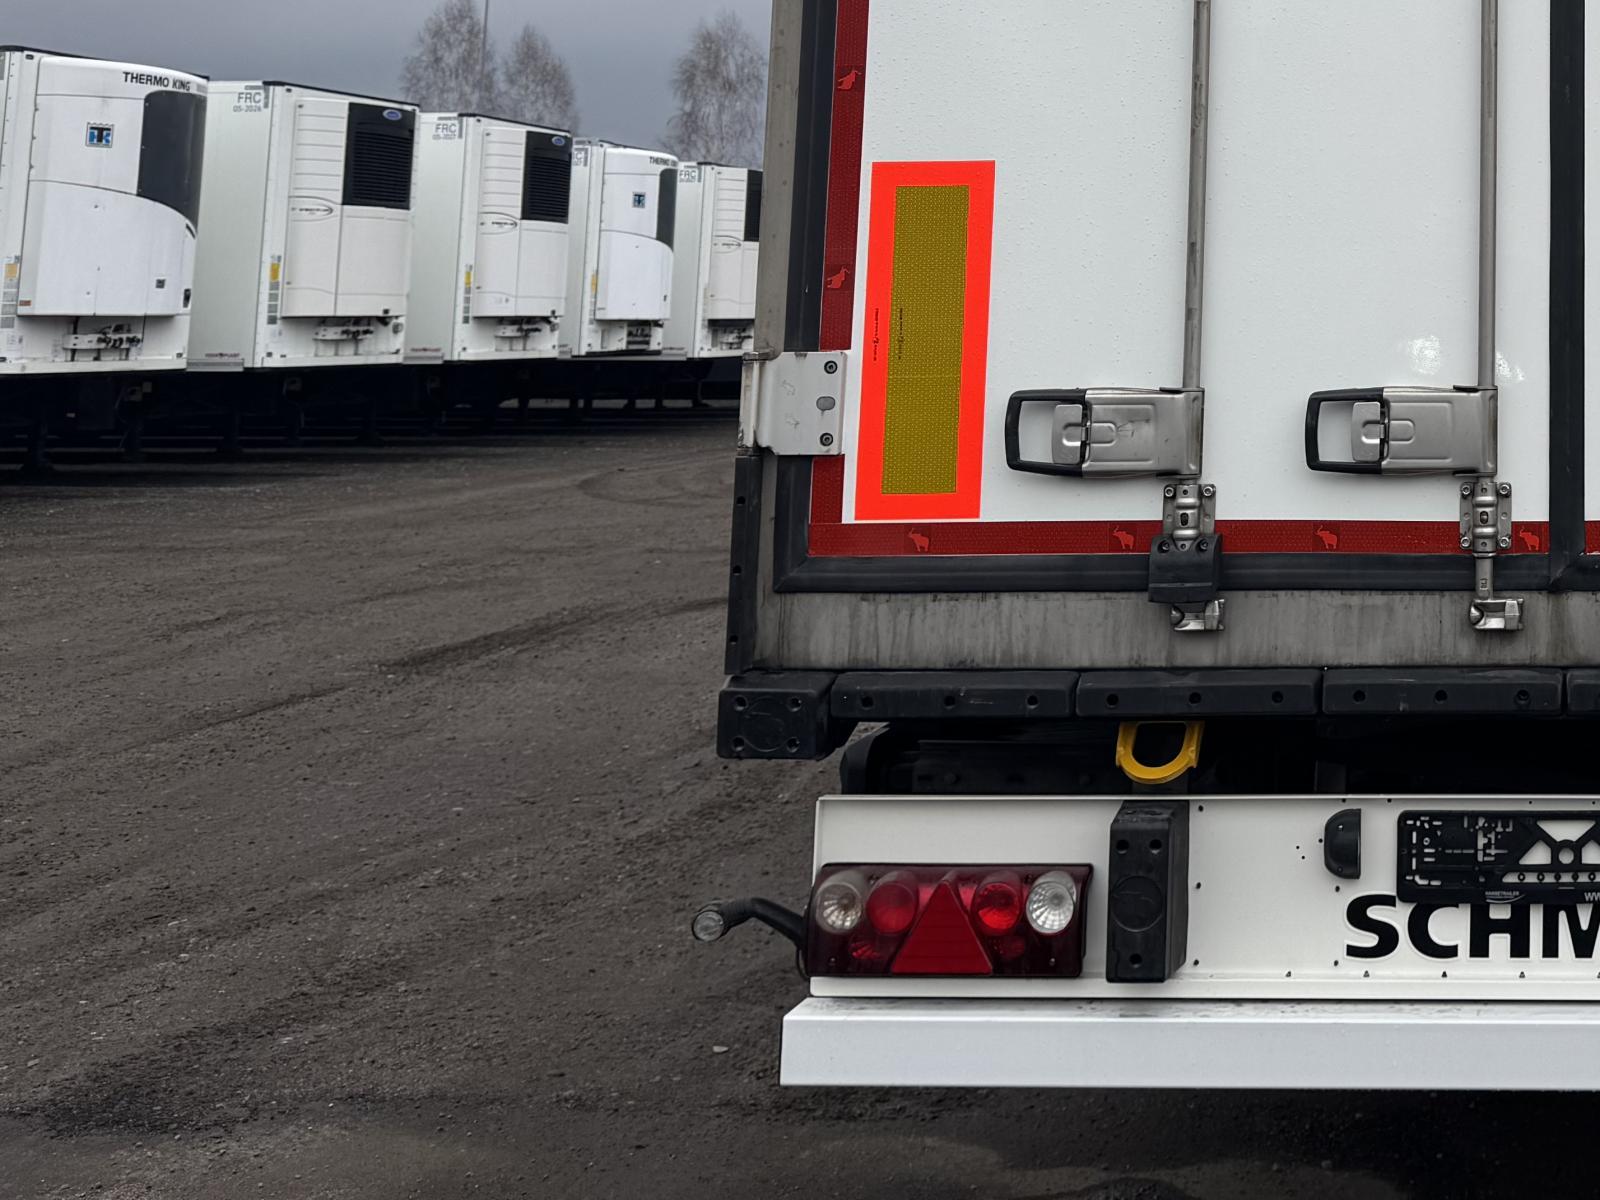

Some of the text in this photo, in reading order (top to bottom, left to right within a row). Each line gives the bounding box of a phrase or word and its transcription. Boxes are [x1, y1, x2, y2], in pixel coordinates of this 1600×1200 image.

[122, 71, 191, 91] THERMO KING
[237, 91, 262, 104] FRC
[435, 122, 457, 134] FRC
